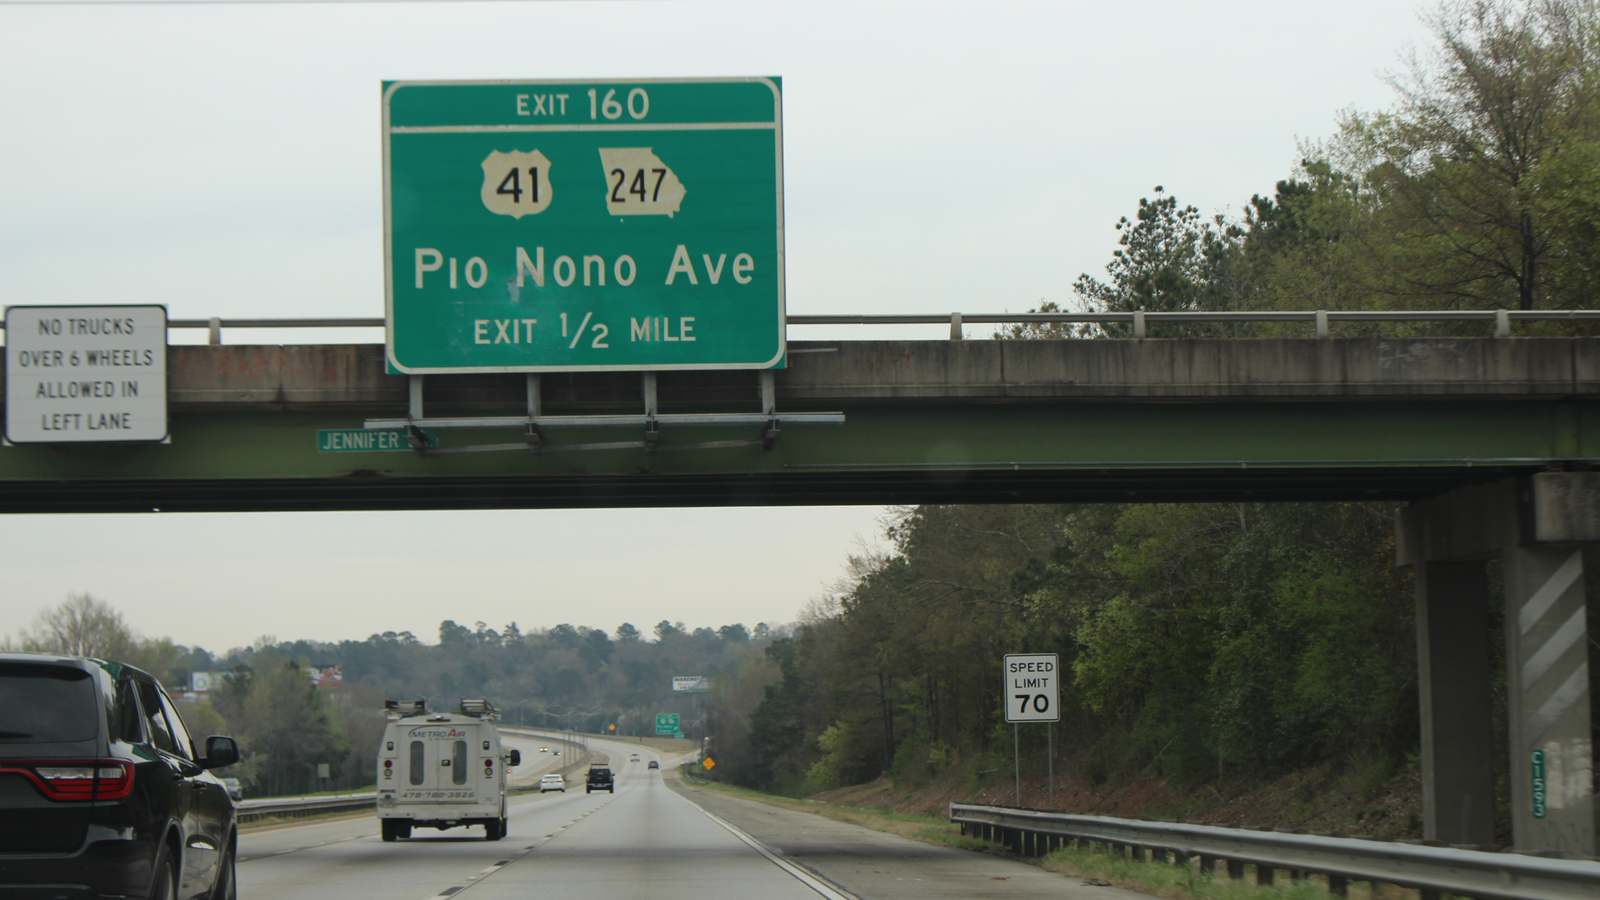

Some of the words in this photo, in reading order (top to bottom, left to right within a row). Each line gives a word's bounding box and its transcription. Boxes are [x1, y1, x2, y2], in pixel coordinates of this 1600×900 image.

[516, 94, 569, 116] EXIT
[587, 88, 650, 120] 160
[496, 167, 539, 203] 41
[610, 168, 667, 202] 247
[515, 246, 637, 288] Nono
[664, 243, 755, 286] Ave
[38, 318, 64, 336] NO
[68, 318, 135, 336] TRUCKS
[474, 318, 537, 345] EXIT
[559, 312, 609, 350] 1/2
[630, 316, 696, 342] MILE
[18, 350, 67, 367] OVER
[70, 350, 80, 367] 6
[86, 349, 154, 367] WHEELS
[36, 381, 117, 399] ALLOWED
[121, 380, 139, 398] IN
[42, 413, 83, 431] LEFT
[87, 412, 131, 430] LANE
[322, 431, 400, 450] JENNIFER
[1009, 662, 1054, 673] SPEED
[1014, 678, 1049, 689] LIMIT
[1014, 693, 1049, 714] 70
